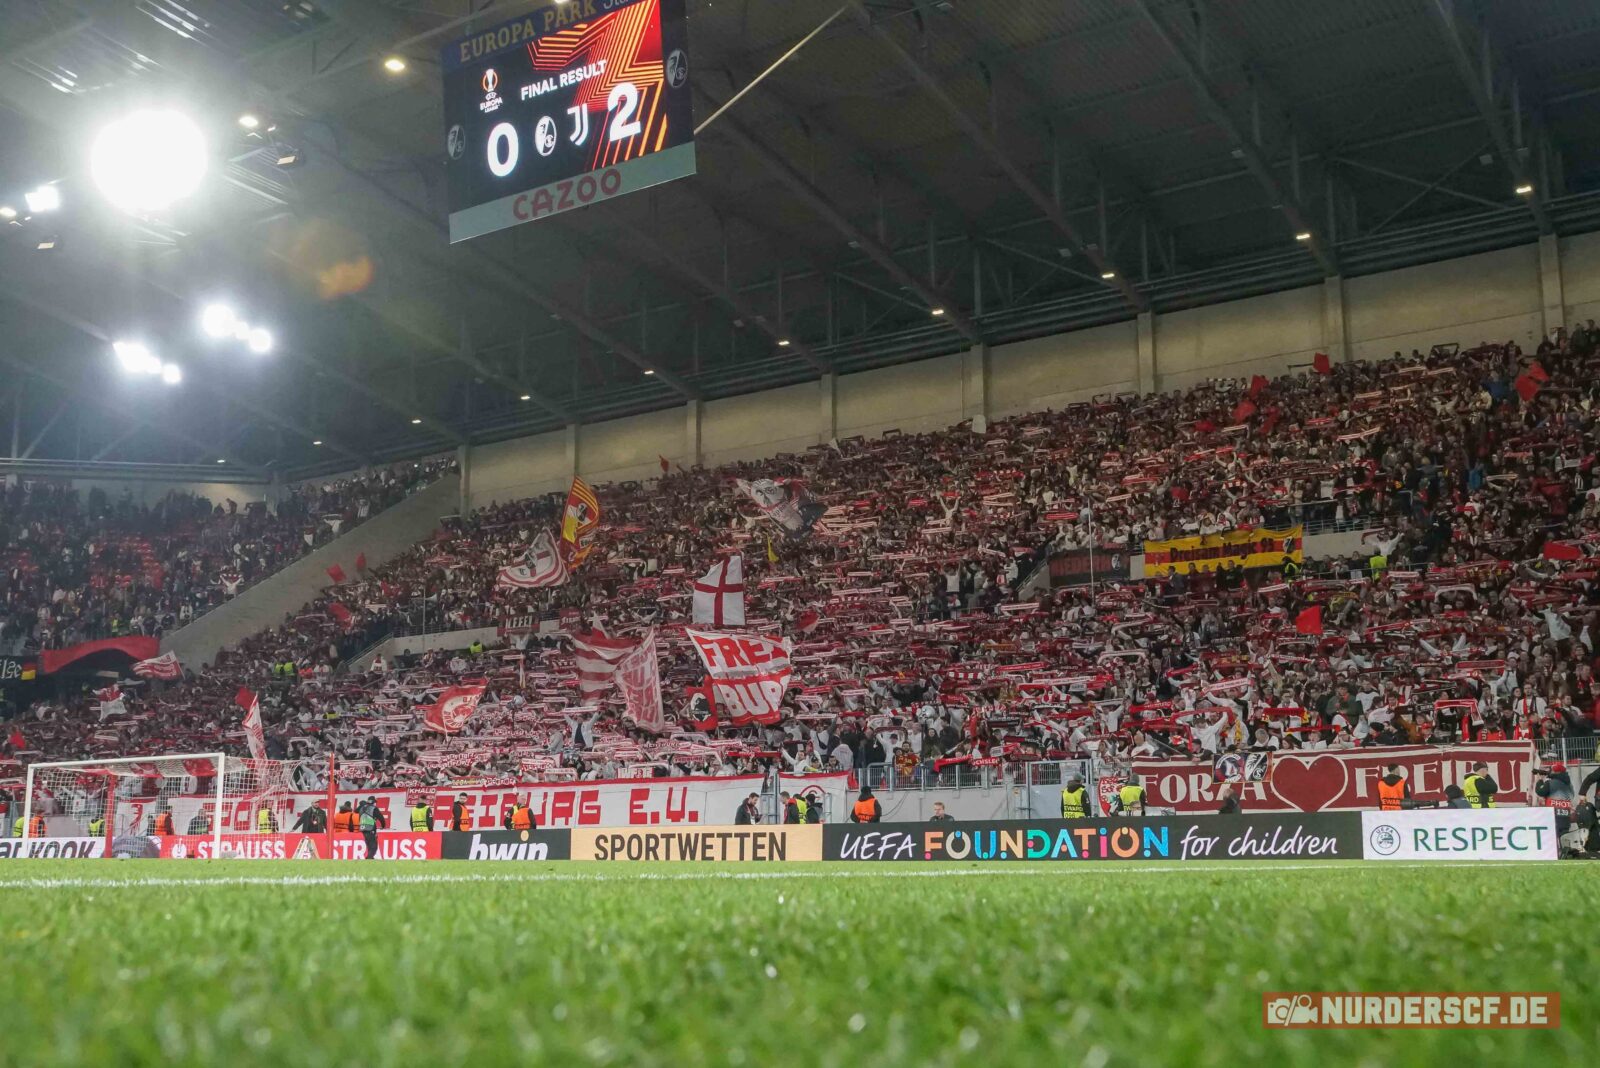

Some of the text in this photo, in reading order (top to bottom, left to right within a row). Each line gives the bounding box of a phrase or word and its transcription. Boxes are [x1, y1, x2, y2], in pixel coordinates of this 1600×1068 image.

[460, 0, 597, 62] EUROPA PARK
[521, 59, 606, 100] FINAL RESULT
[487, 82, 641, 176] 0 2
[513, 168, 621, 220] CAZOO
[434, 789, 601, 827] REIBURG
[469, 830, 548, 860] bwin
[594, 832, 786, 861] SPORTWETTEN
[840, 825, 1338, 860] UEFA FOUNDATION for children
[1414, 826, 1548, 851] RESPECT
